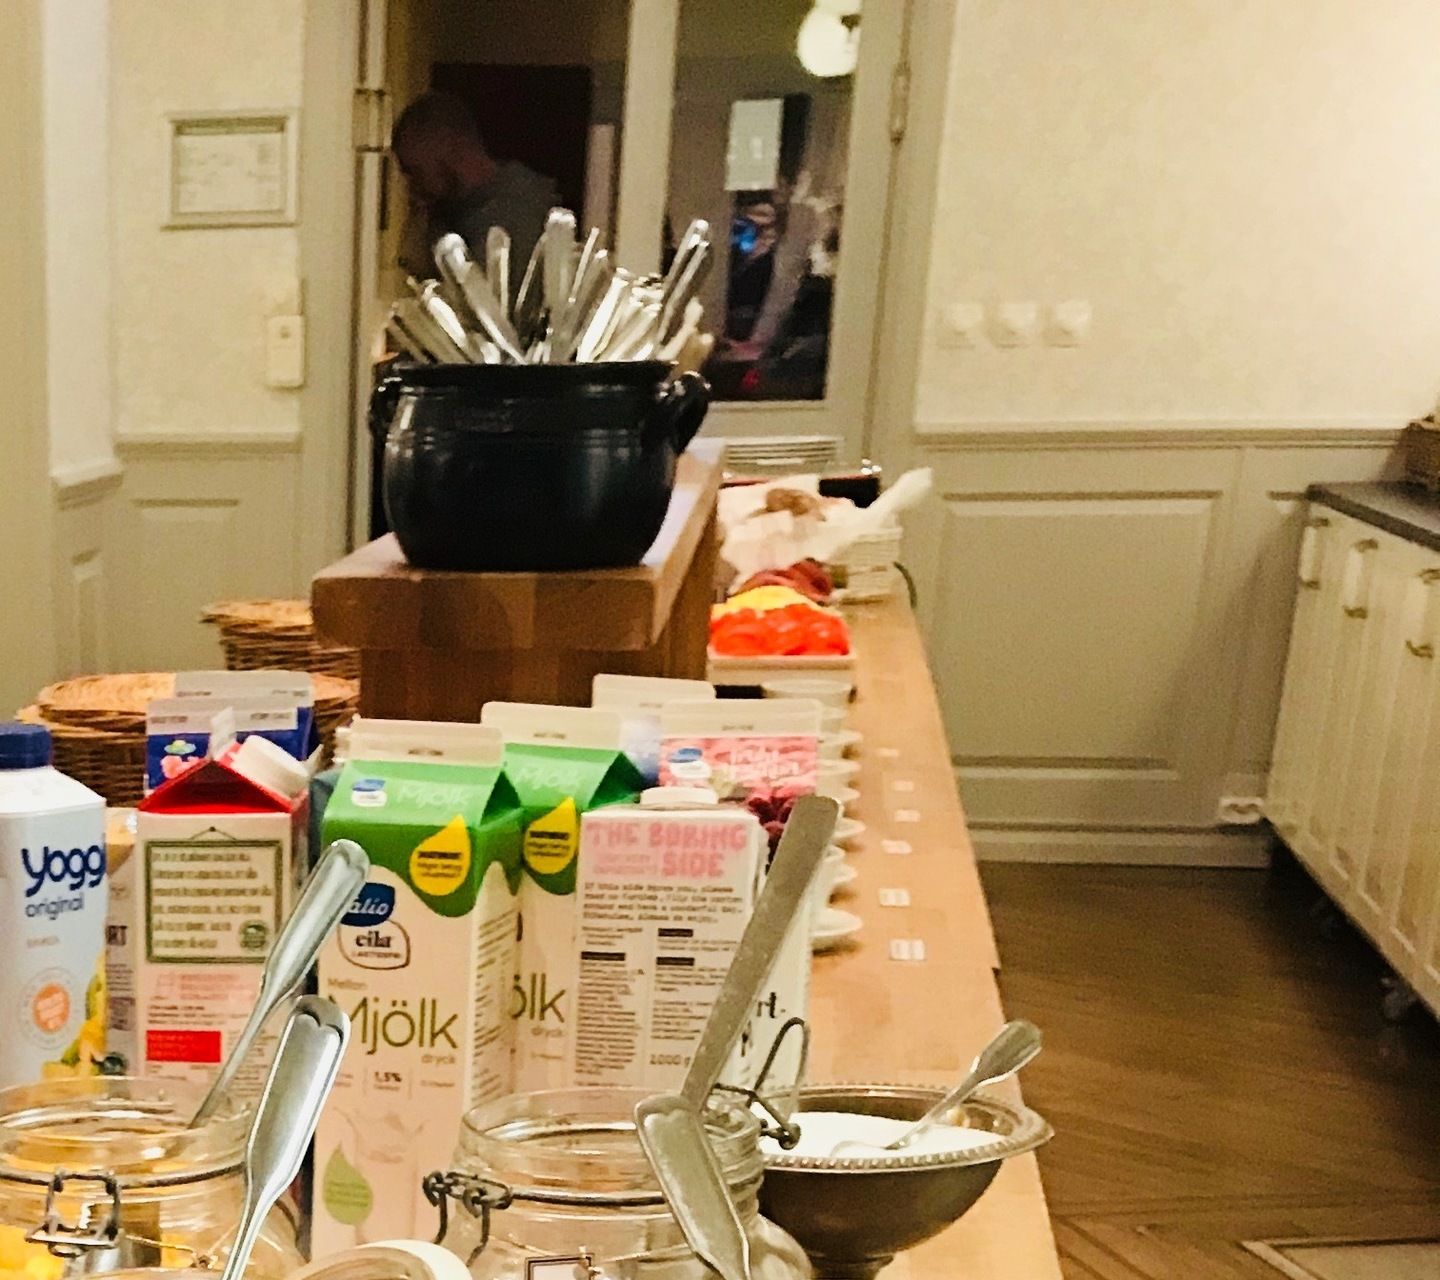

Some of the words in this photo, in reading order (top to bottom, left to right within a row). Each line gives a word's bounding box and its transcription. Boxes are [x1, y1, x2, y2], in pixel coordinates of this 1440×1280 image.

[585, 822, 641, 847] THE
[649, 822, 747, 852] BORING
[662, 852, 724, 877] SIDE
[25, 892, 85, 921] original
[348, 896, 390, 915] alio
